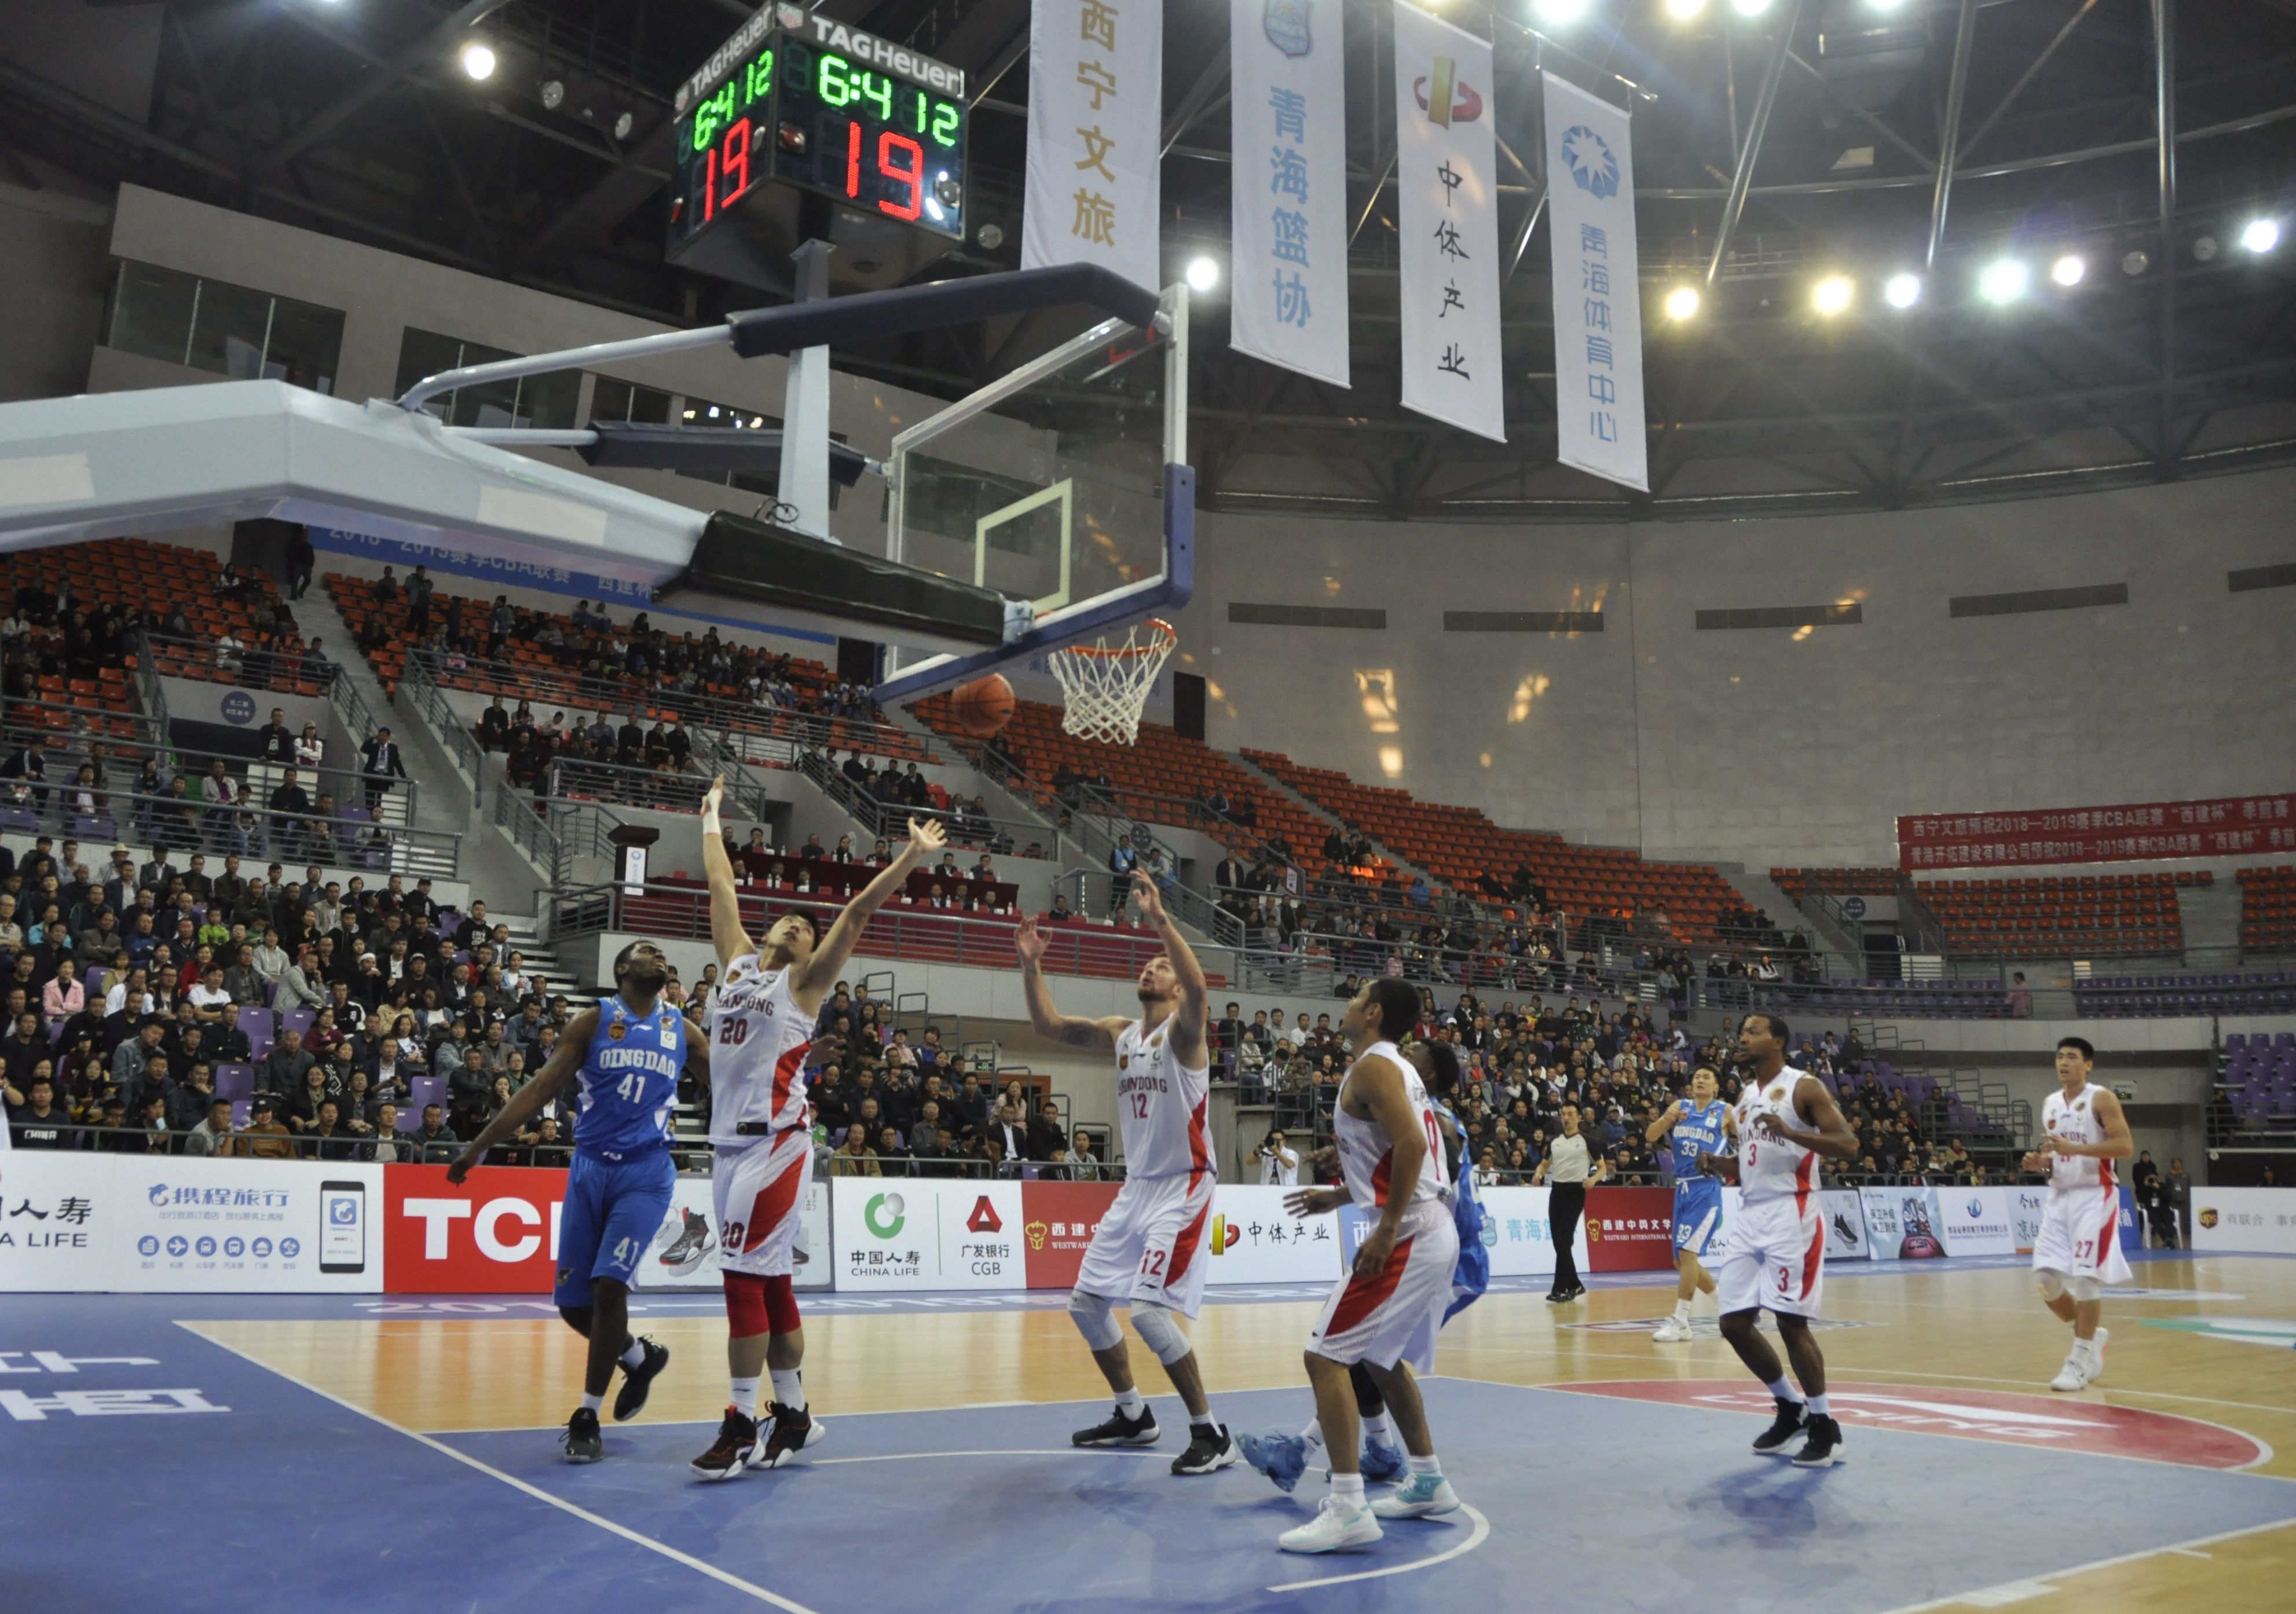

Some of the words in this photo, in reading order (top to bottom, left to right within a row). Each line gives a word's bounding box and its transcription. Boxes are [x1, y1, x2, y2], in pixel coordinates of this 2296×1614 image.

[1073, 0, 1118, 248] 西宁文旅
[704, 117, 750, 222] 19
[847, 121, 923, 222] 19
[1269, 86, 1313, 328] 青海篮协
[1433, 159, 1471, 380] 中体产业
[1580, 222, 1617, 443] 青海体育中心
[720, 1018, 748, 1045] 20
[617, 1073, 646, 1104] 41
[1131, 1093, 1148, 1119] 12
[1681, 1140, 1699, 1157] 33
[1748, 1143, 1757, 1167] 3
[173, 1187, 290, 1207] 携程旅行
[0, 1196, 92, 1225] 人寿
[28, 1233, 87, 1247] LIFE
[403, 1197, 563, 1263] TC
[1248, 1221, 1330, 1247] 中体产业
[613, 1237, 640, 1266] 41
[851, 1250, 920, 1266] 中国人寿
[961, 1244, 1009, 1258] 广发银行
[1141, 1250, 1166, 1276] 12
[2075, 1241, 2094, 1259] 27
[851, 1267, 889, 1276] CHINA
[894, 1267, 920, 1276] LIFE
[971, 1262, 1001, 1276] CGB
[1778, 1267, 1789, 1293] 3
